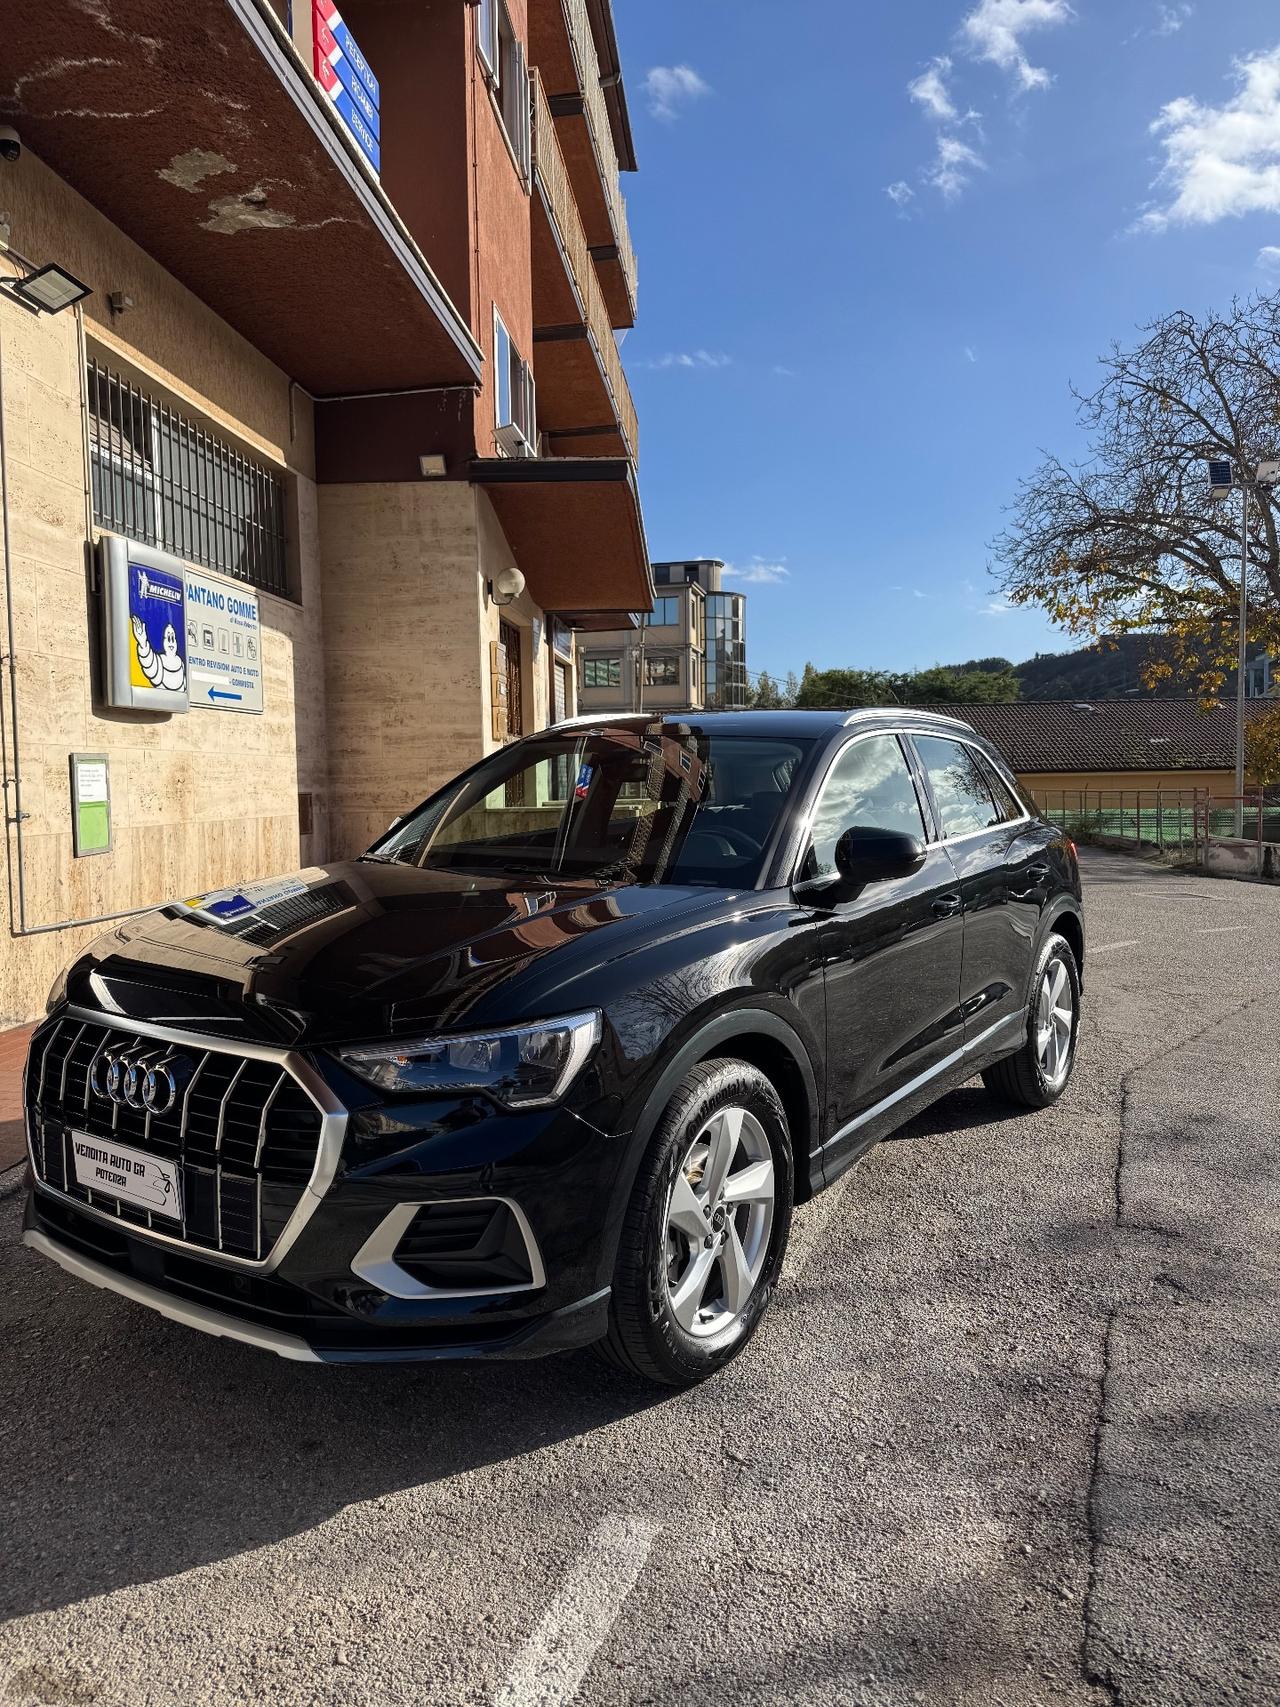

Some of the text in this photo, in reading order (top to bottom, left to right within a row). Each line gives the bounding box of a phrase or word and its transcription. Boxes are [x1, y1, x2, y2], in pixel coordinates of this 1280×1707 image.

[351, 109, 374, 153] SERVICE
[150, 584, 181, 601] MICHELIN
[185, 583, 257, 620] ANTANO GOMME
[206, 660, 230, 672] REVISIONI
[230, 665, 242, 674] AUTO
[75, 1142, 145, 1177] VENDITA AUTO GR
[95, 1166, 127, 1187] POTENZA
